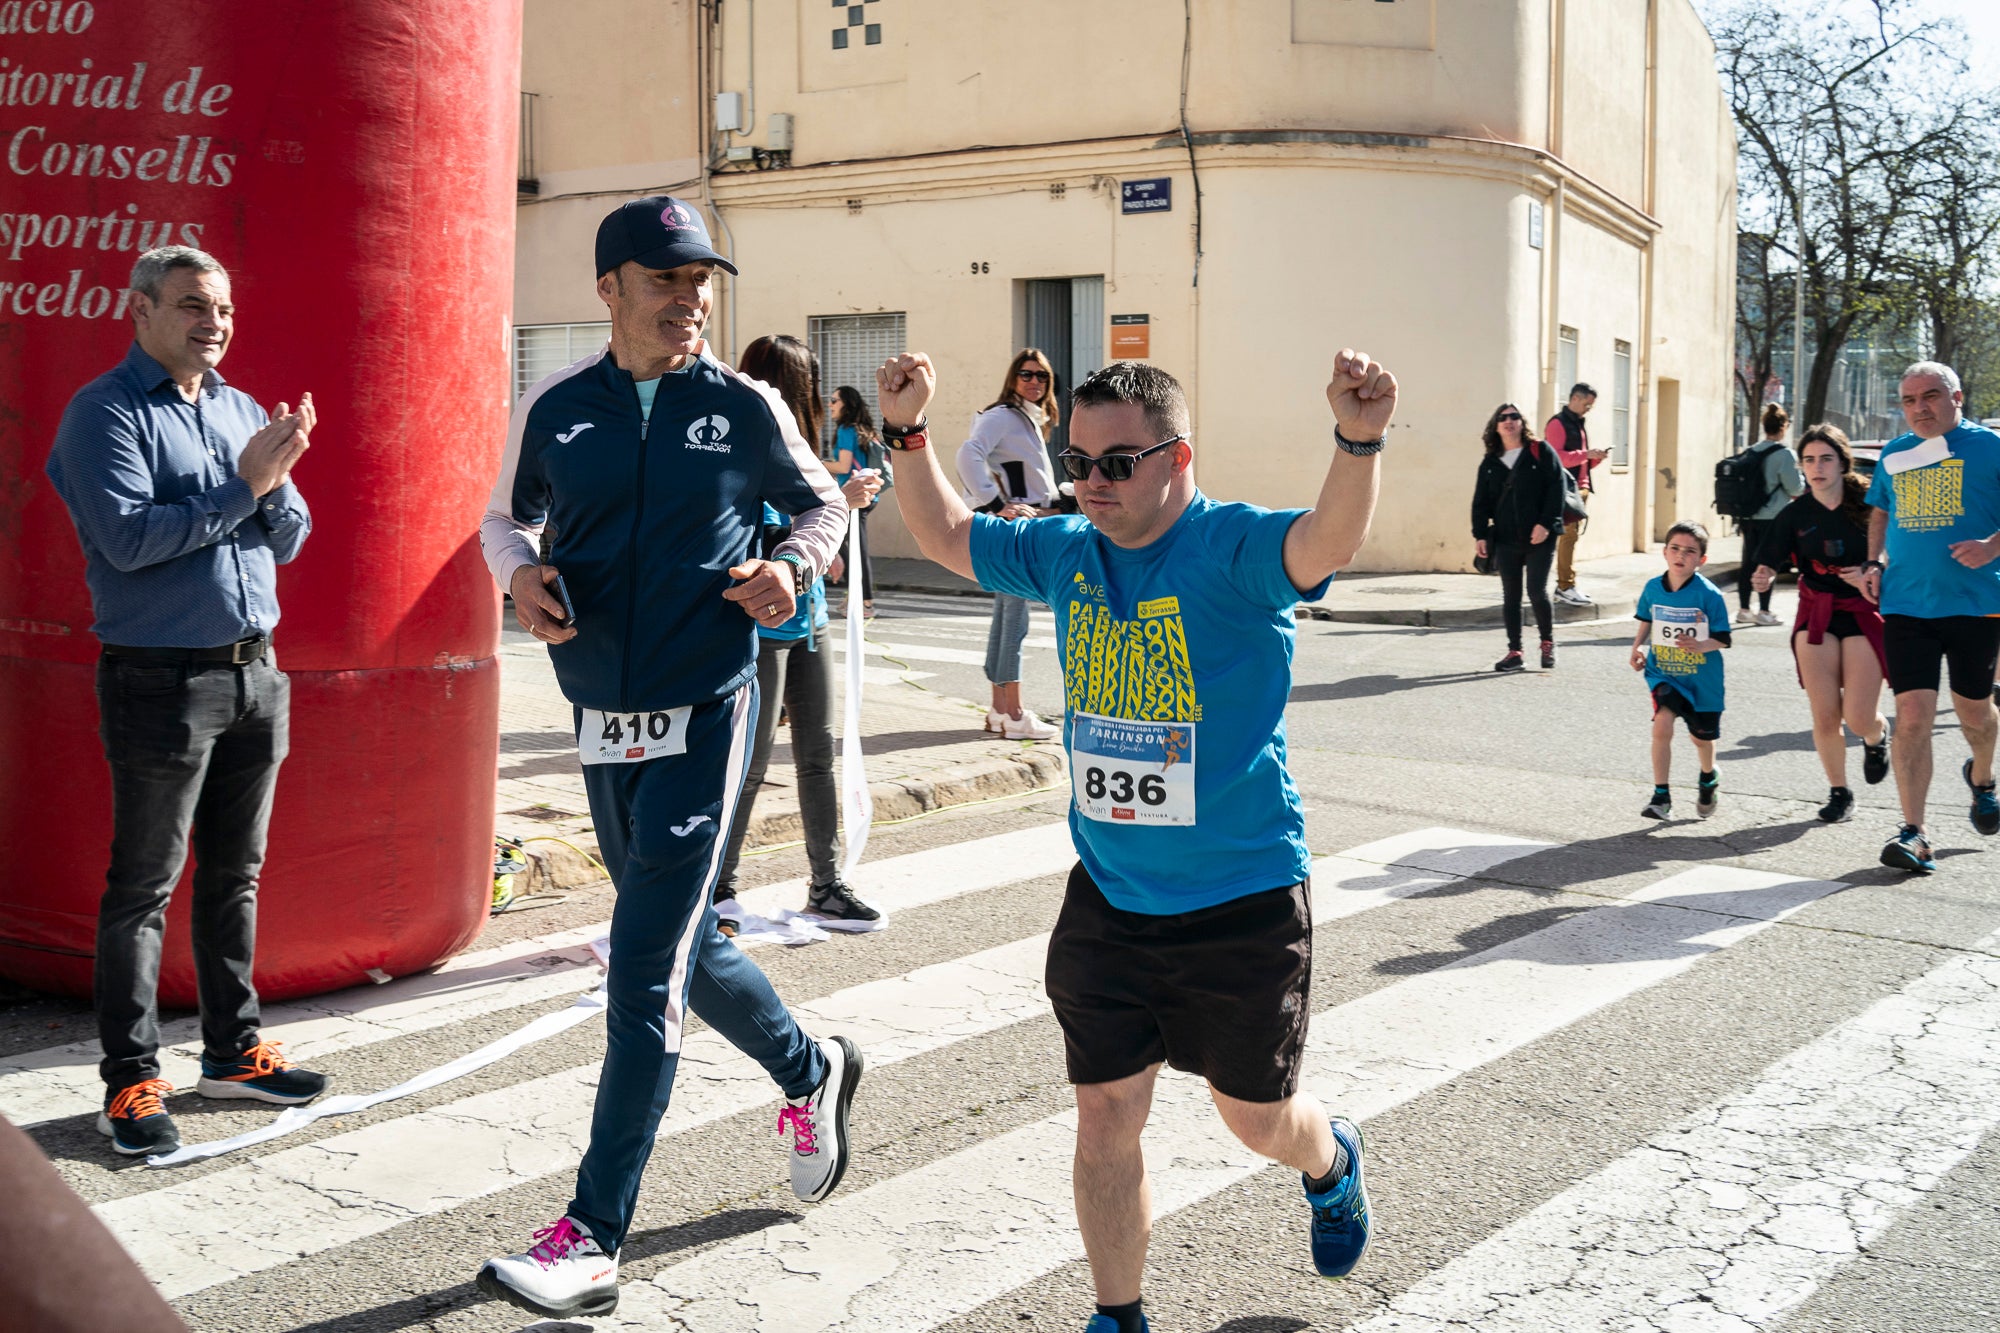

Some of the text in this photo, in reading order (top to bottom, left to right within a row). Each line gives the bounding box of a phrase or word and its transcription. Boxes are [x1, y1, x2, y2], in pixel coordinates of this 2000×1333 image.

[162, 66, 233, 117] de
[7, 125, 236, 187] Consells
[970, 261, 990, 275] 96
[1149, 606, 1177, 616] Terrassa
[1662, 626, 1697, 639] 620
[601, 712, 671, 744] 410
[1089, 726, 1166, 745] PARKINSON
[1085, 767, 1167, 806] 836
